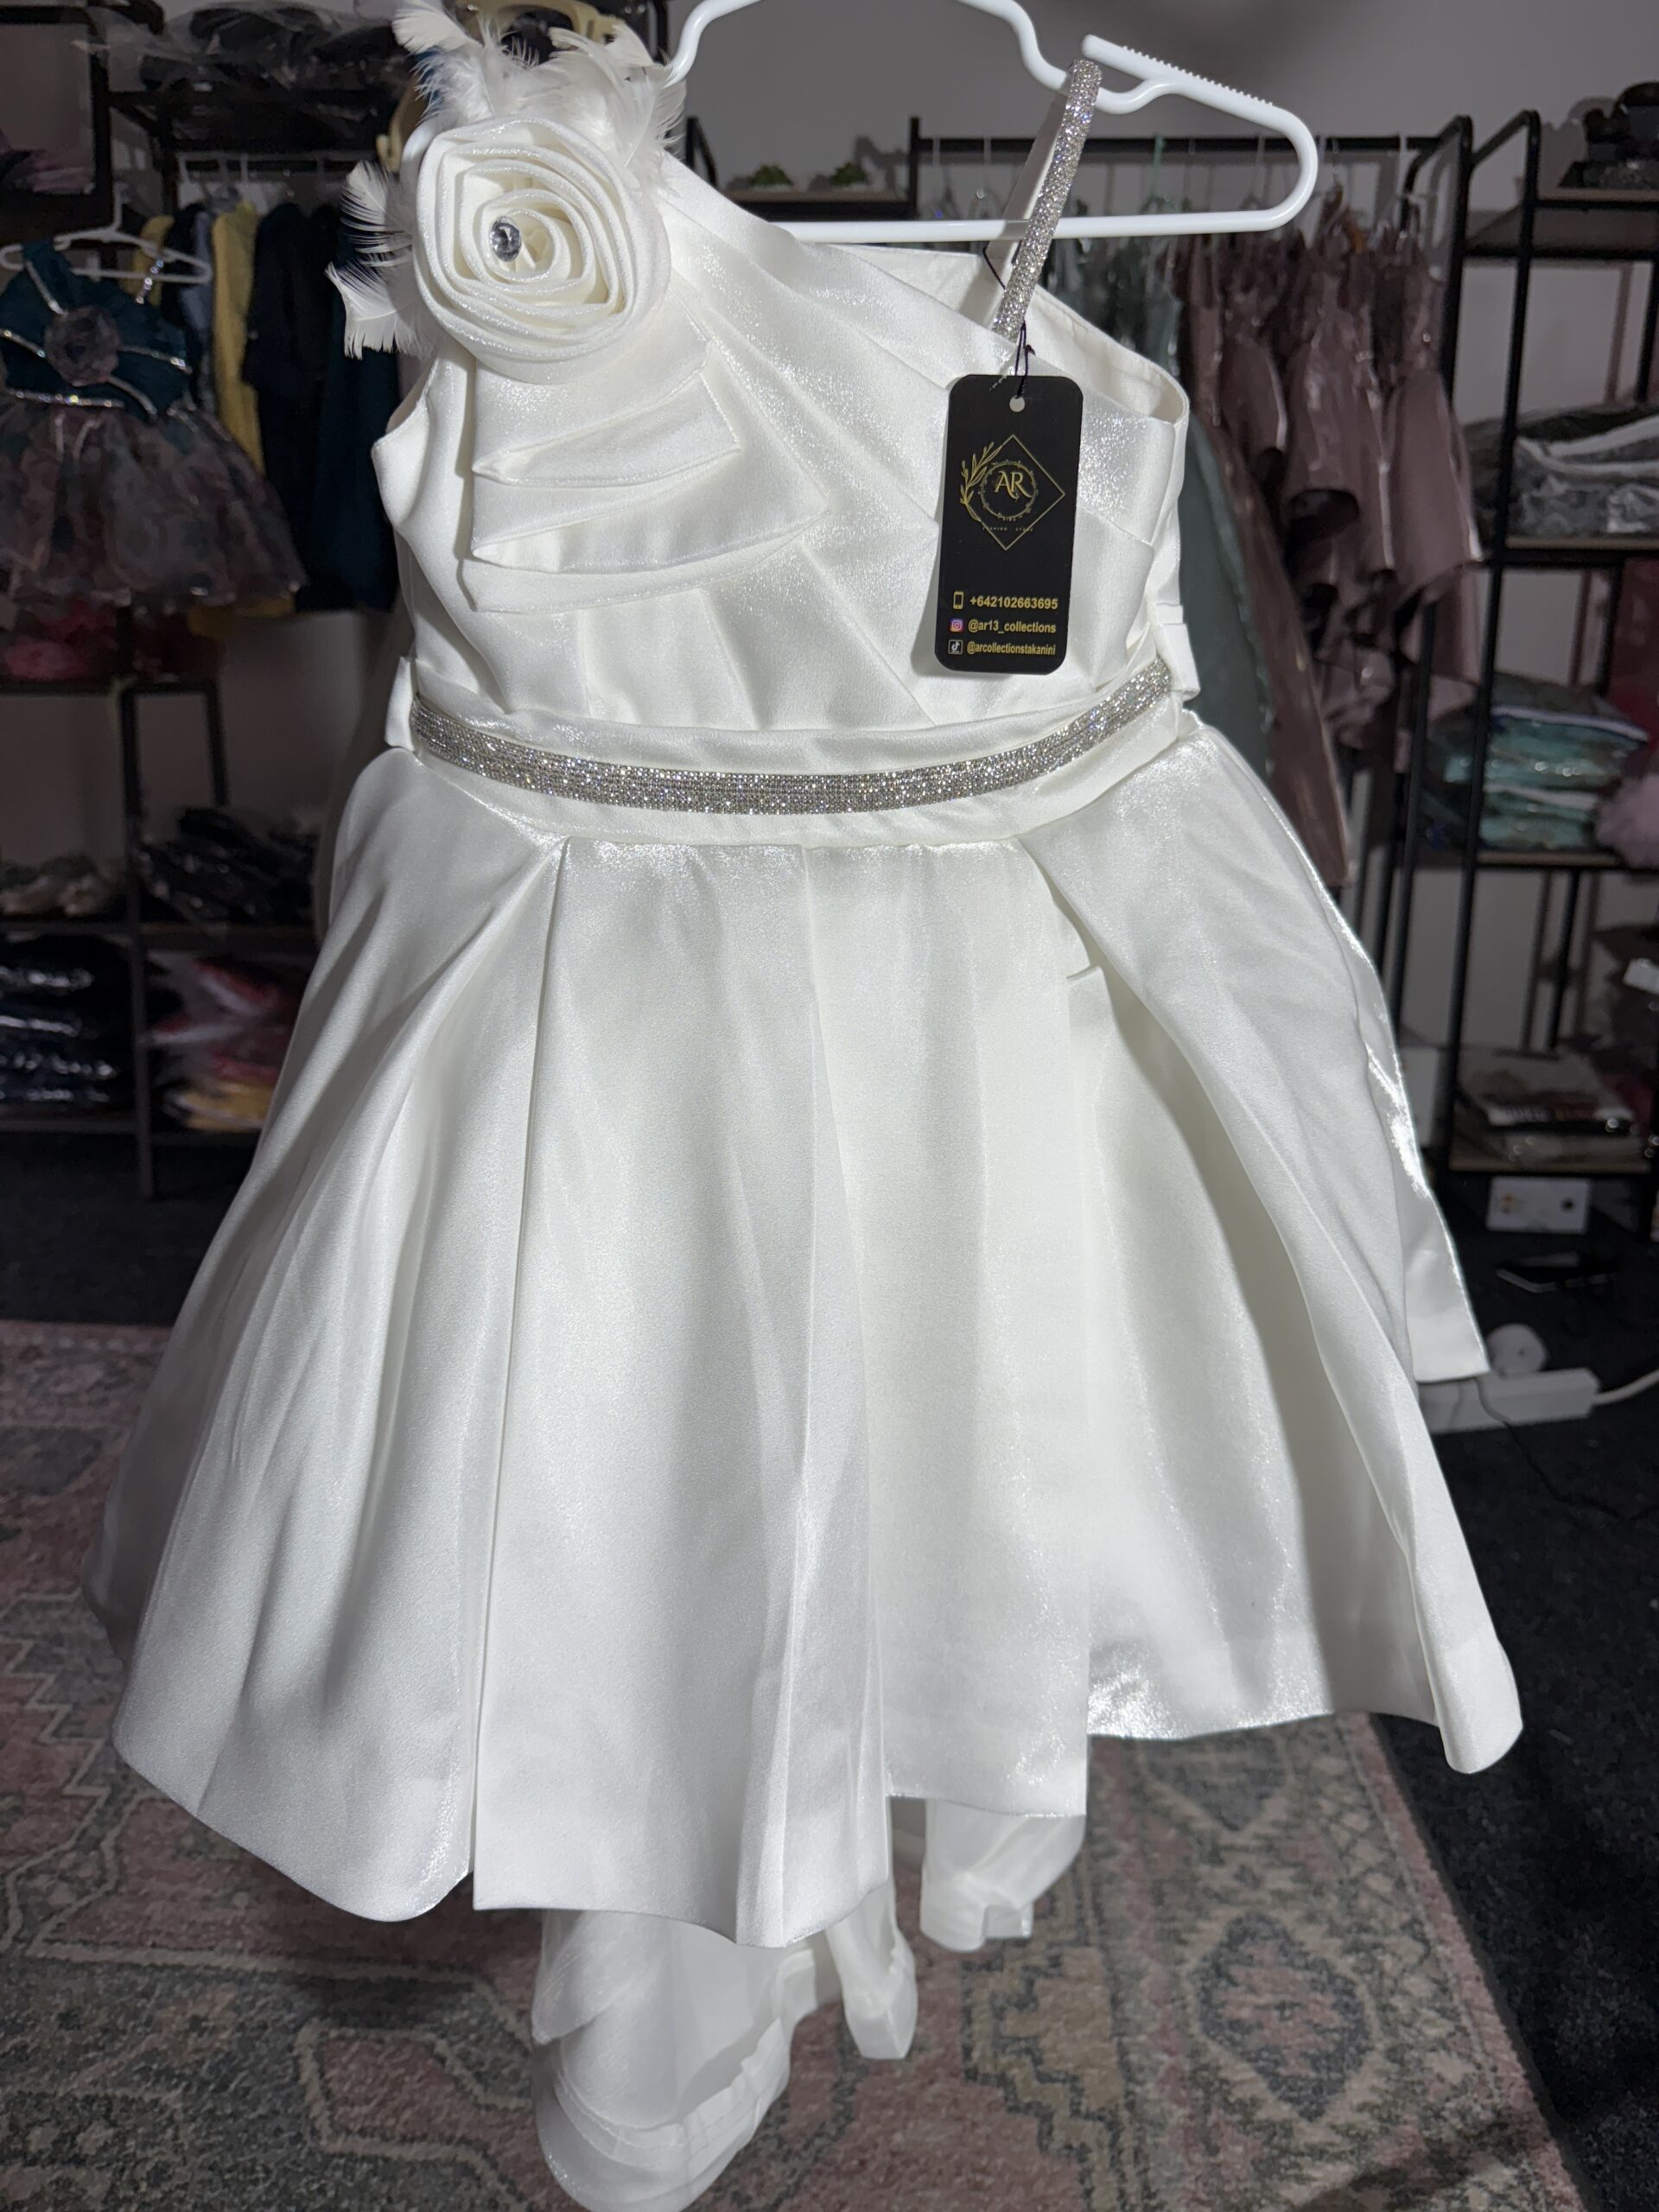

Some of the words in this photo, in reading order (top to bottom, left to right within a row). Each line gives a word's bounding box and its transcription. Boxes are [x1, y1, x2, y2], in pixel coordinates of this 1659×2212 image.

[995, 471, 1033, 499] AR
[969, 595, 1058, 610] +642102663695
[968, 619, 1057, 634] @ar13_collections
[967, 641, 1056, 656] @arcollectionstakanini
